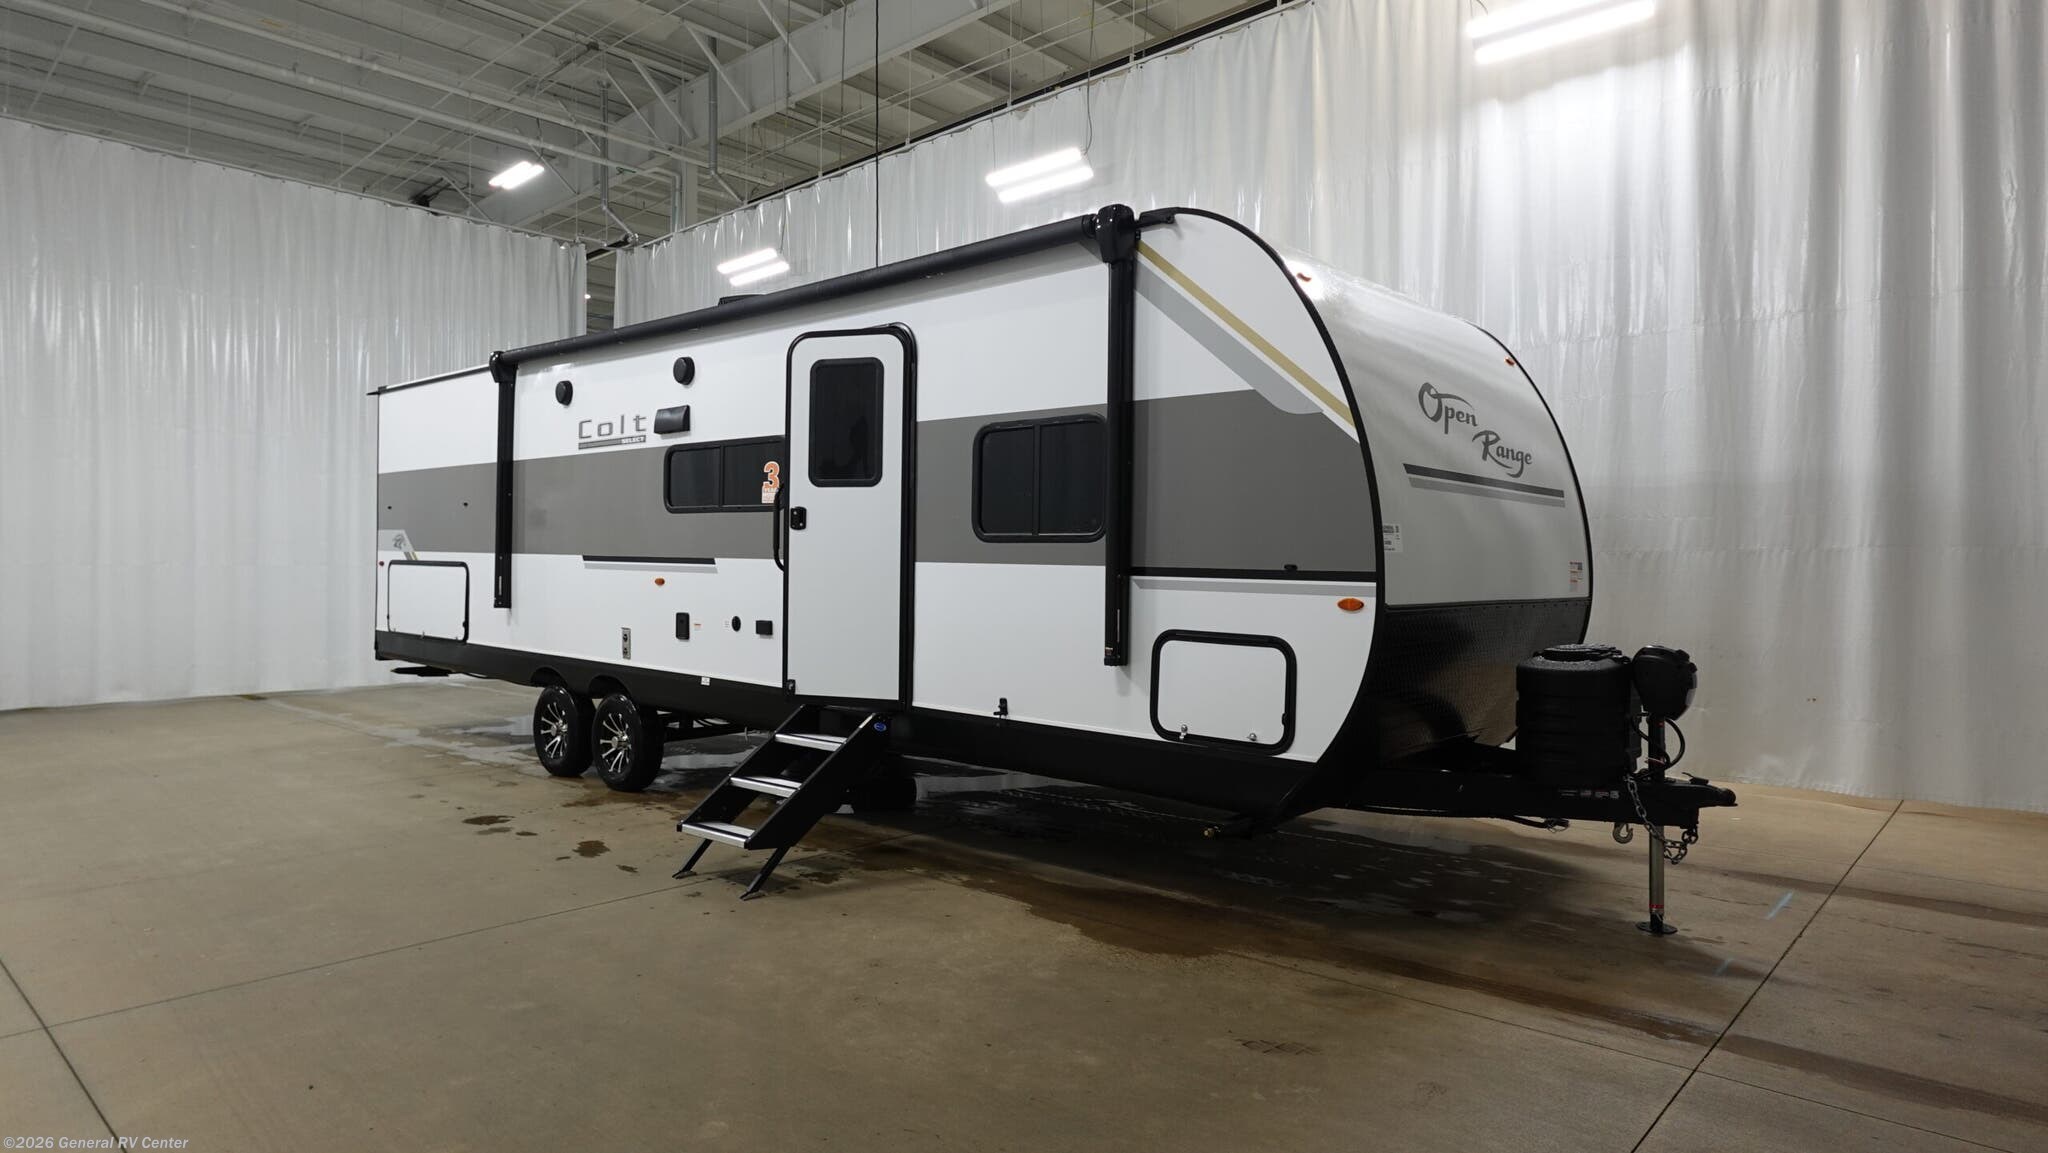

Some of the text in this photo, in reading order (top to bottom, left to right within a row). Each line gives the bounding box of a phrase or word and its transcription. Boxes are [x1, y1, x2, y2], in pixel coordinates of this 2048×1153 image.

[1418, 382, 1478, 434] Open
[579, 414, 646, 439] Colt
[621, 436, 645, 444] SELECT
[1472, 429, 1533, 478] Range
[763, 461, 780, 489] 3
